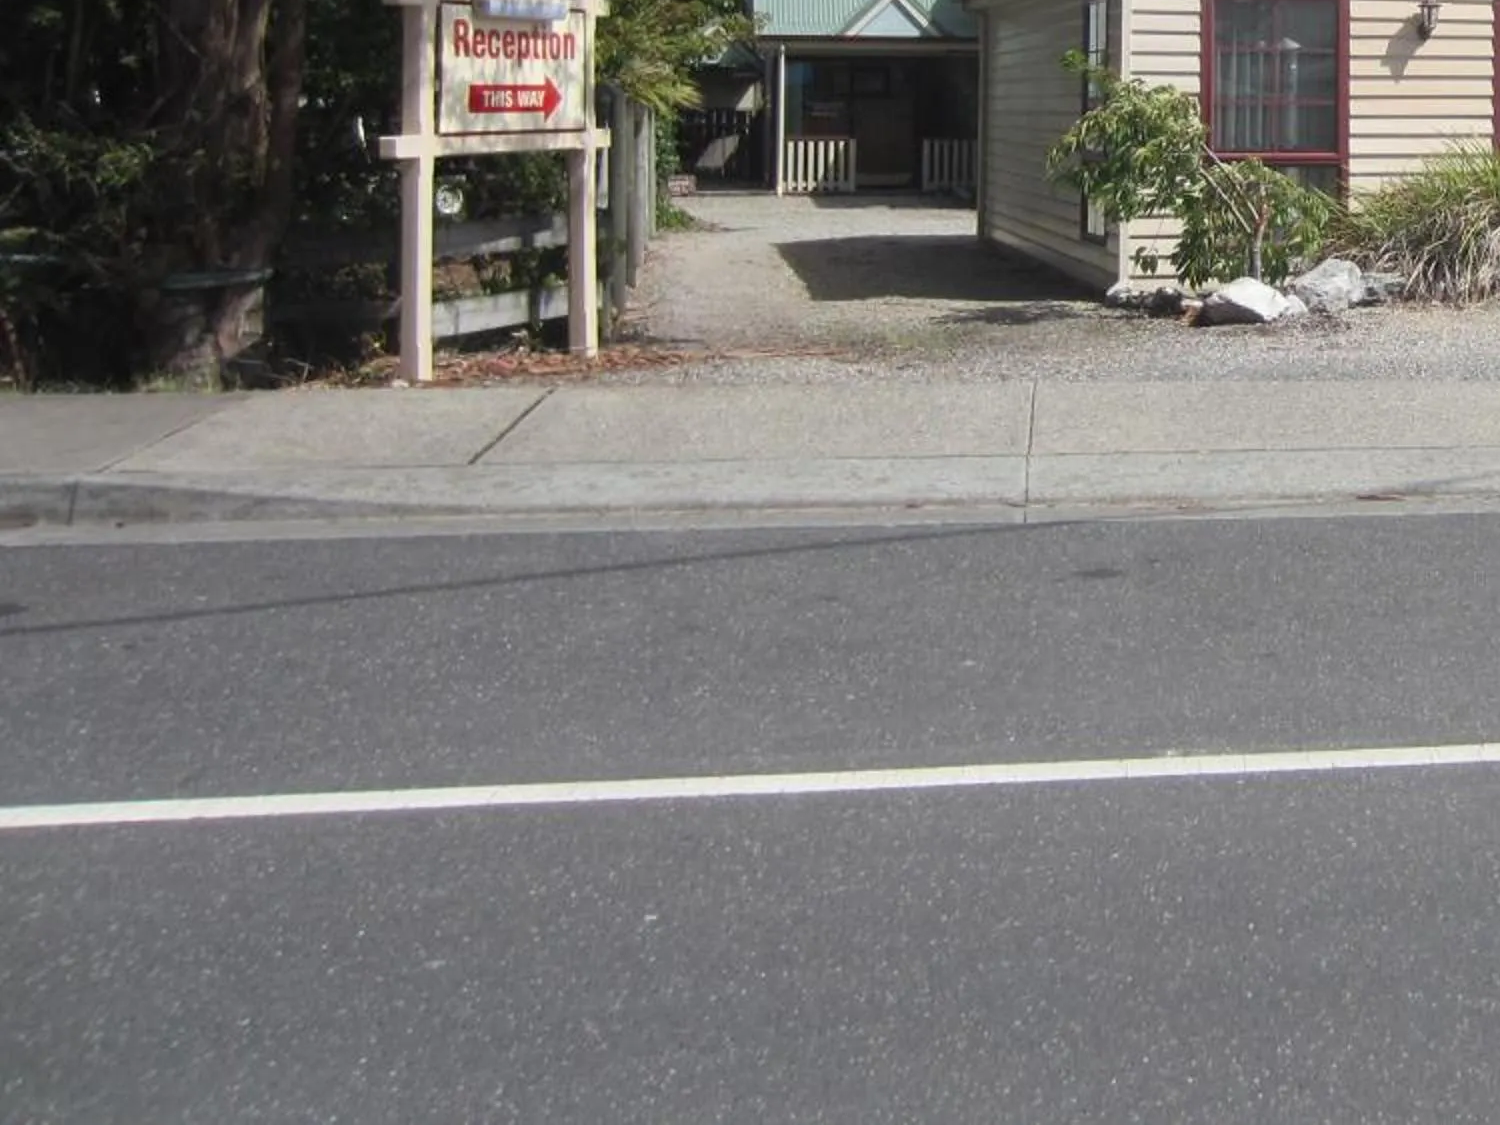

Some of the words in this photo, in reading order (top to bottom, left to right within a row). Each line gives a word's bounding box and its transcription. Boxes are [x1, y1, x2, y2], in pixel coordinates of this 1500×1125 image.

[453, 18, 575, 66] Reception
[482, 90, 513, 108] THIS
[517, 90, 546, 107] WAY
